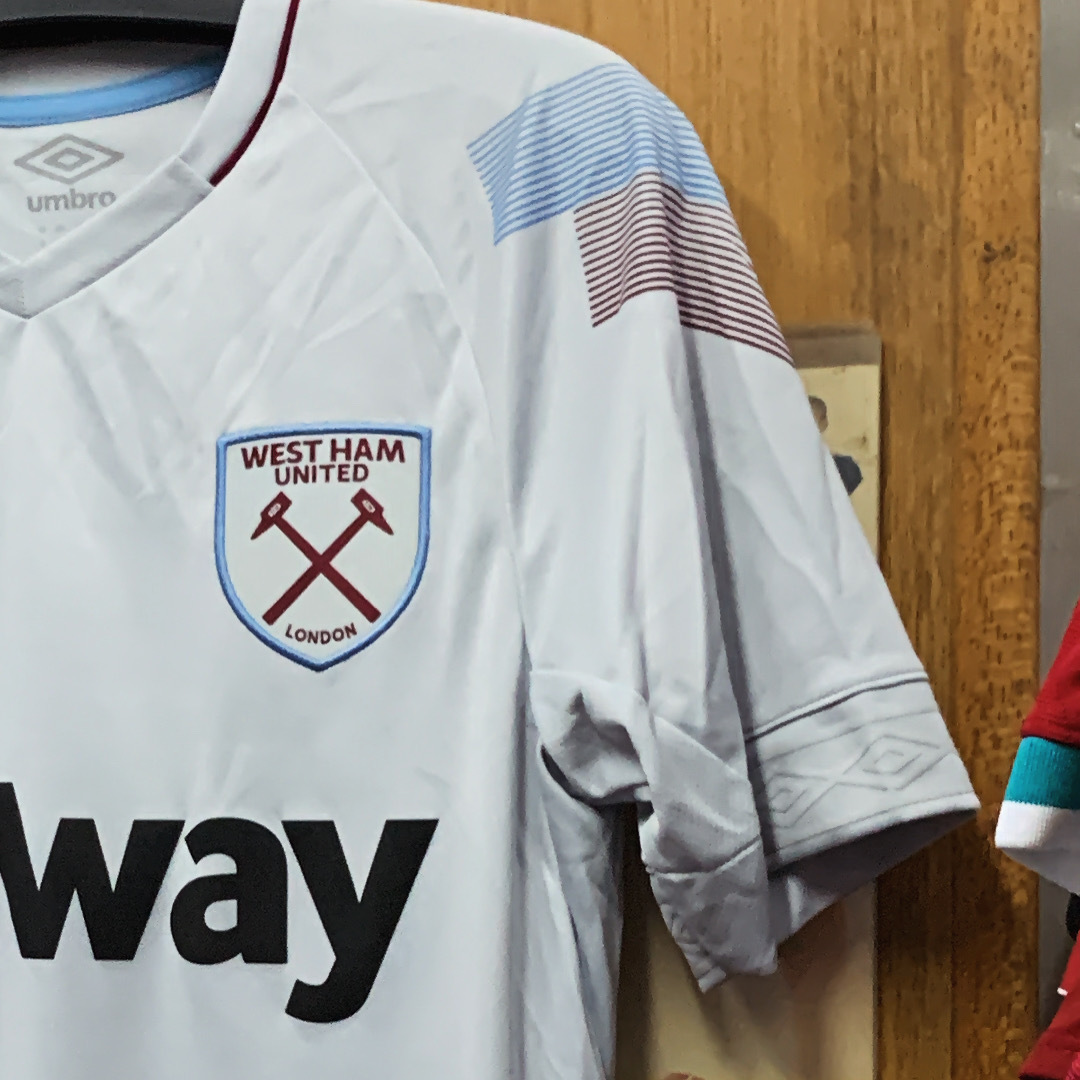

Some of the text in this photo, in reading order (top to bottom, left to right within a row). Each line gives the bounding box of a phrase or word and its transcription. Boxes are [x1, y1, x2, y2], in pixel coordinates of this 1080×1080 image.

[26, 188, 117, 212] umbro
[241, 438, 405, 469] WEST HAM
[274, 464, 369, 486] UNITED
[285, 623, 358, 645] LONDON
